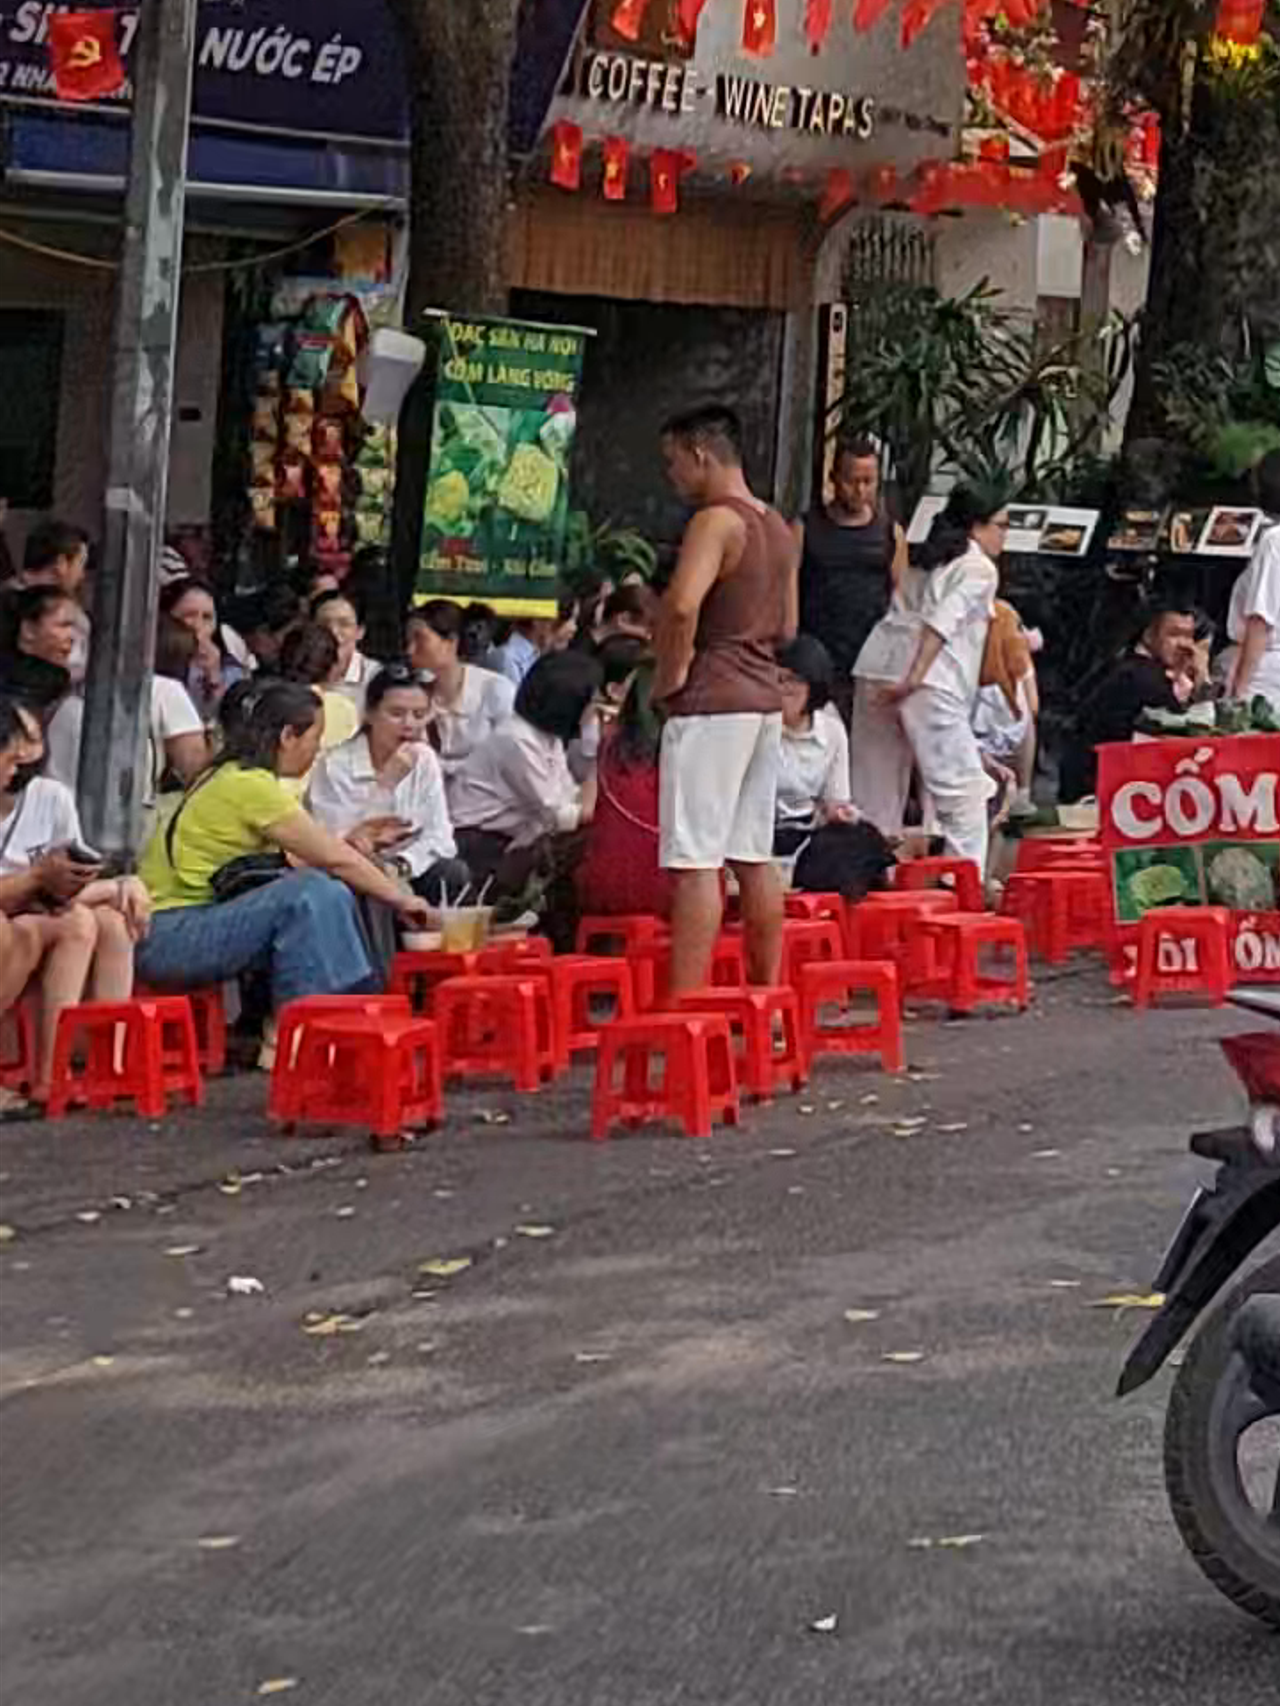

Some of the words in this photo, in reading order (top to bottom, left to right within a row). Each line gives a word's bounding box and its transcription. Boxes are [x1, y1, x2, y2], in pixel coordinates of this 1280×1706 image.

[199, 25, 312, 75] NƯỚC
[312, 33, 362, 84] ÉP
[588, 54, 698, 113] COFFEE
[723, 74, 789, 129] WINE
[797, 87, 875, 139] TAPAS
[1111, 746, 1280, 839] CỐM
